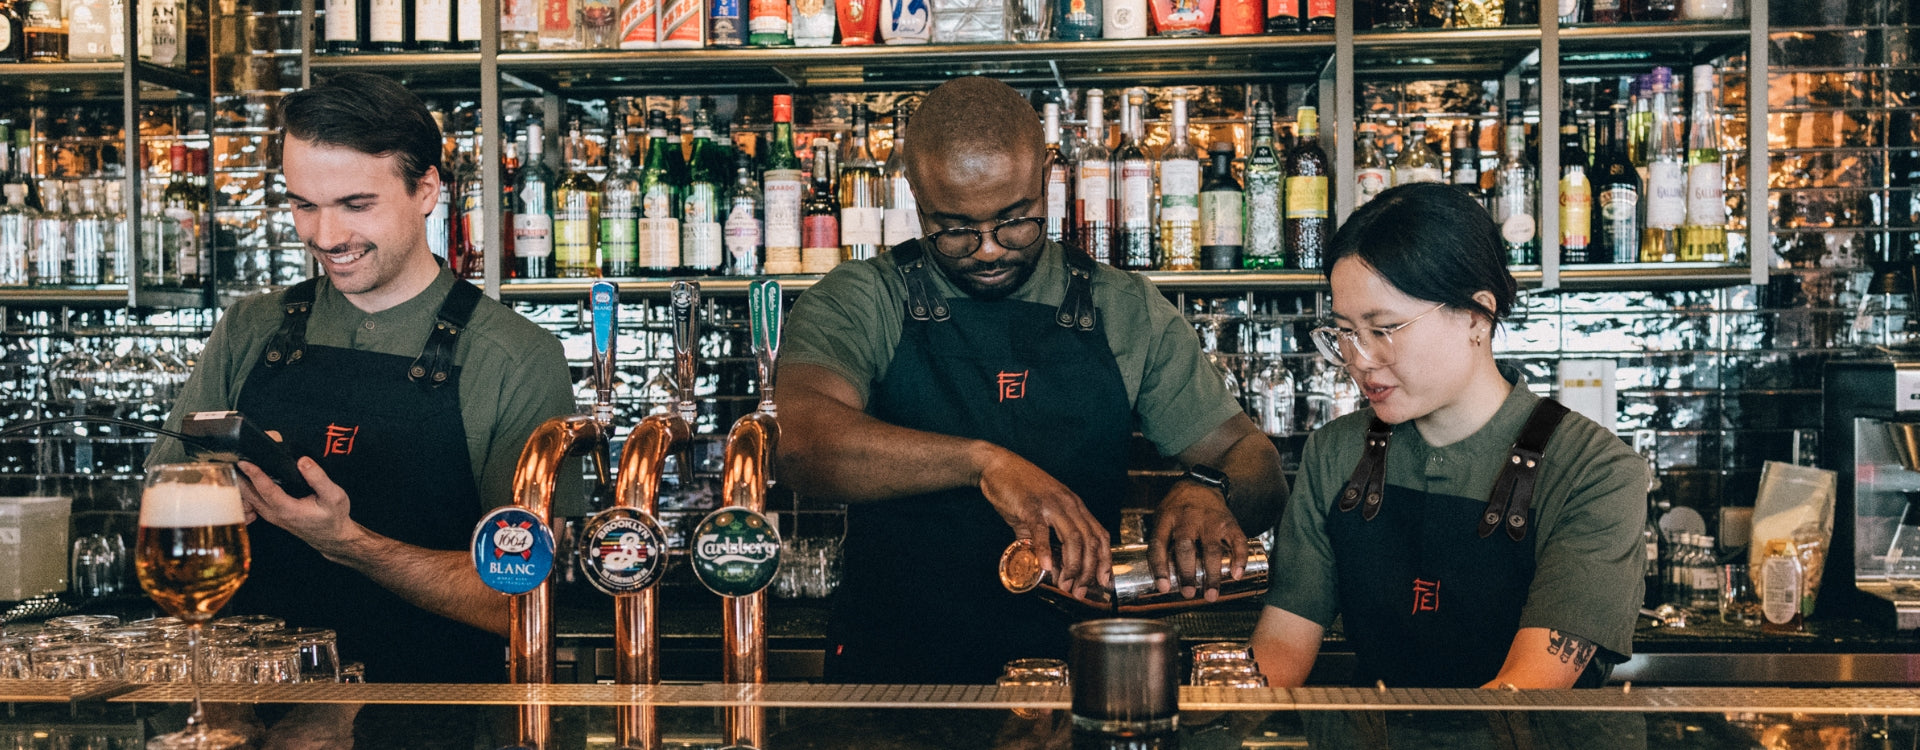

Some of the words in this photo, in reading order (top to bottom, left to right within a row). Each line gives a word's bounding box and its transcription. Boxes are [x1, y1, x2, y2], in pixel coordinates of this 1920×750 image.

[151, 6, 174, 17] AN
[597, 520, 650, 540] BROOKLYN
[498, 532, 528, 548] 1664
[697, 533, 777, 566] Carlsberg
[489, 562, 535, 576] BLANC
